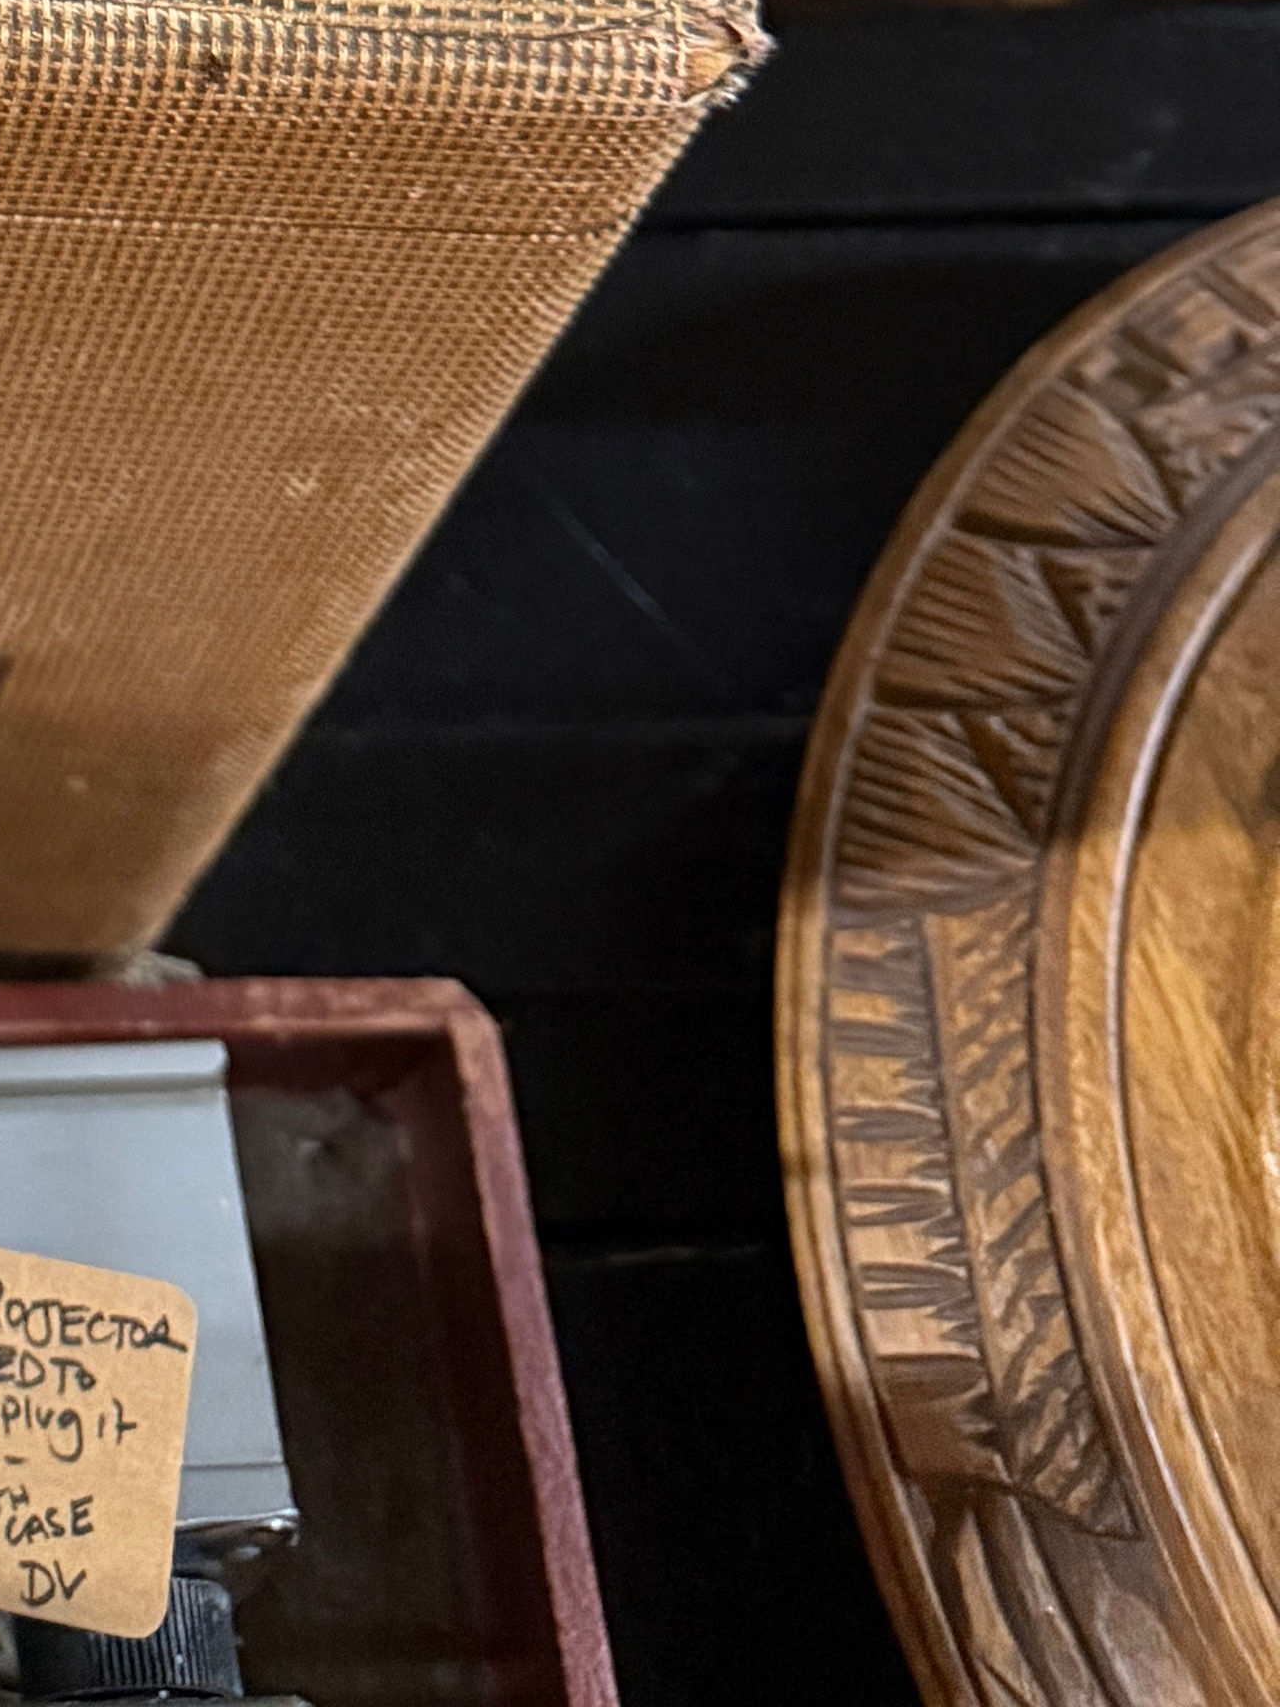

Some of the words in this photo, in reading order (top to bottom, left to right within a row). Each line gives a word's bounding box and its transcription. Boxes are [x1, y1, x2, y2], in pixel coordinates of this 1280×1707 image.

[1, 1395, 84, 1463] plug
[97, 1398, 137, 1445] it
[4, 1495, 95, 1545] CASE
[18, 1559, 87, 1607] DV
